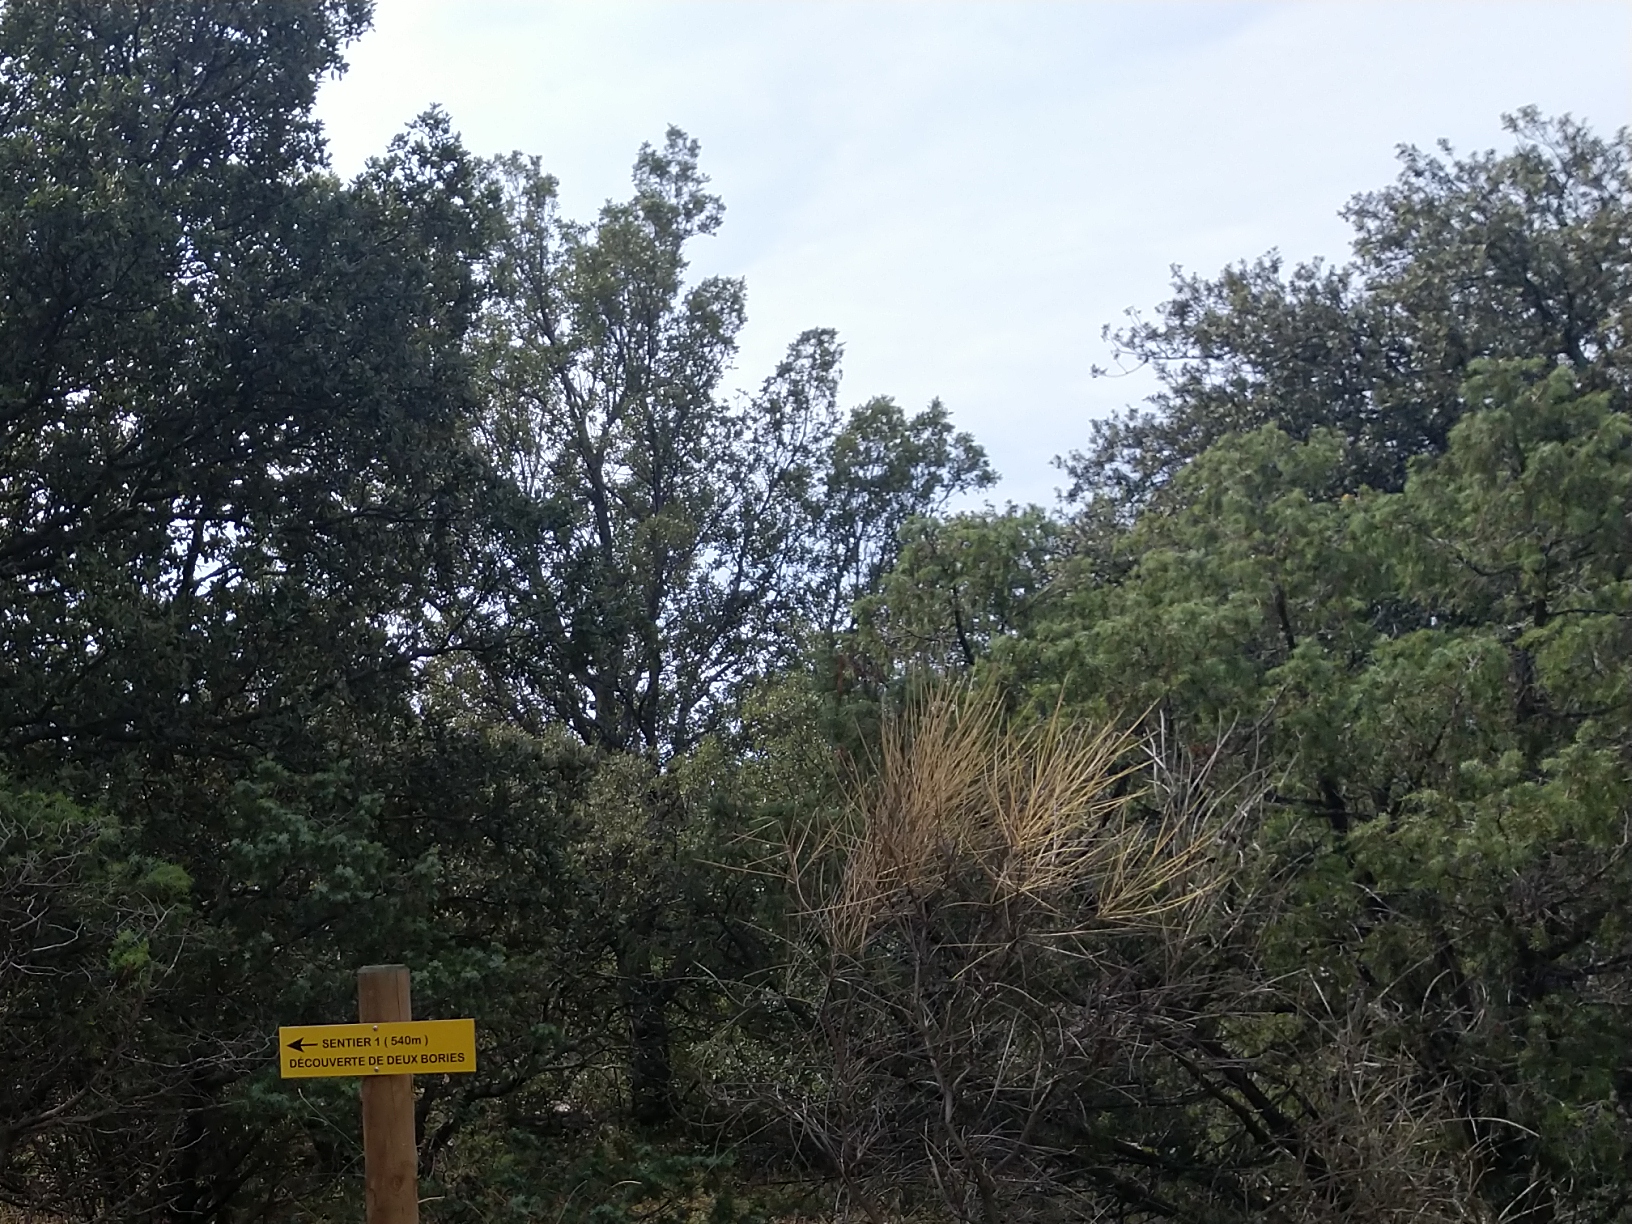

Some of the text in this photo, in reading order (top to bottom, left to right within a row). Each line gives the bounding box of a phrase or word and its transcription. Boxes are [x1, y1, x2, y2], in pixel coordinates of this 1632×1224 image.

[322, 1037, 372, 1049] SENTIER
[374, 1036, 380, 1047] 1
[391, 1035, 422, 1046] 540m
[289, 1052, 465, 1068] DÉCOUVERTE DE DEUX BORIES
